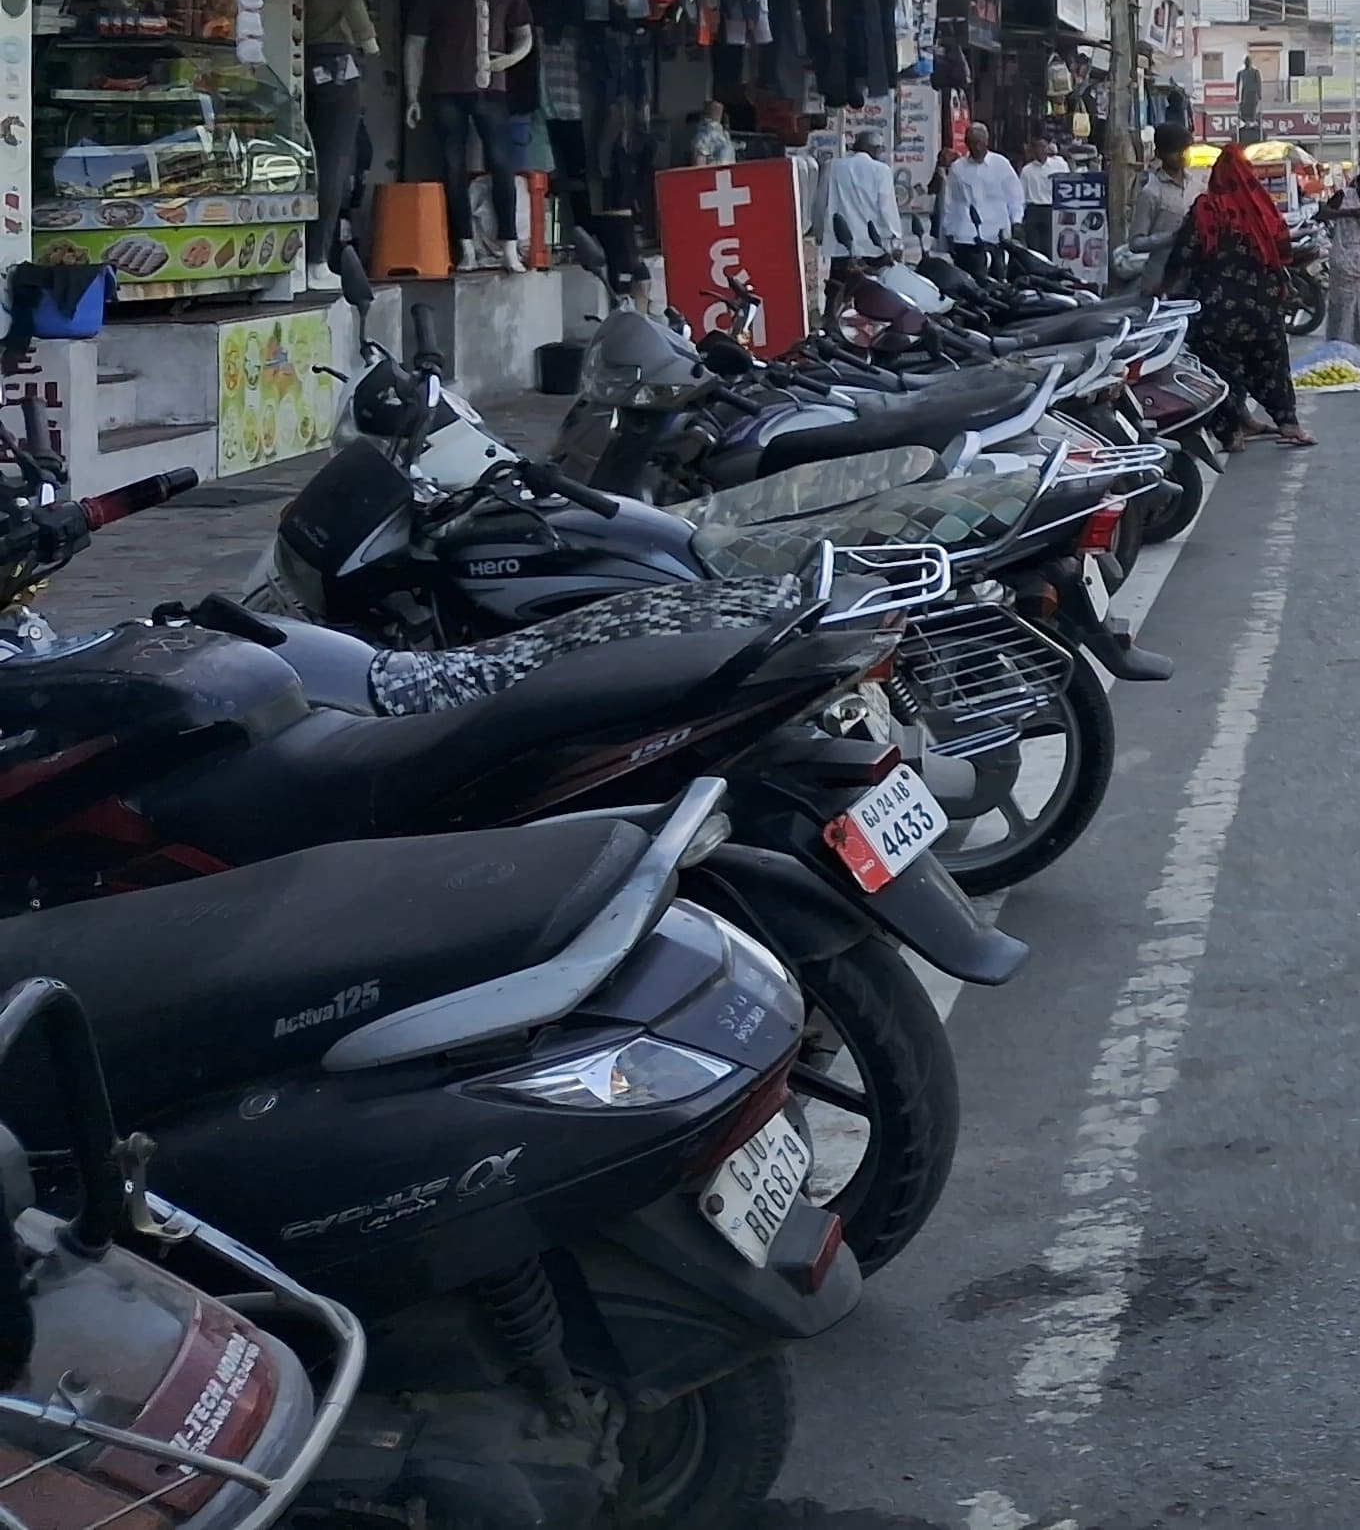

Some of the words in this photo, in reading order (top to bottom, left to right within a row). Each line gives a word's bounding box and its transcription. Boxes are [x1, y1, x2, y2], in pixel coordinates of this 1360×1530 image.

[861, 805, 880, 828] GJ
[878, 792, 896, 816] 24
[890, 780, 911, 805] AB
[881, 801, 935, 857] 4433
[744, 1133, 806, 1247] BR6879
